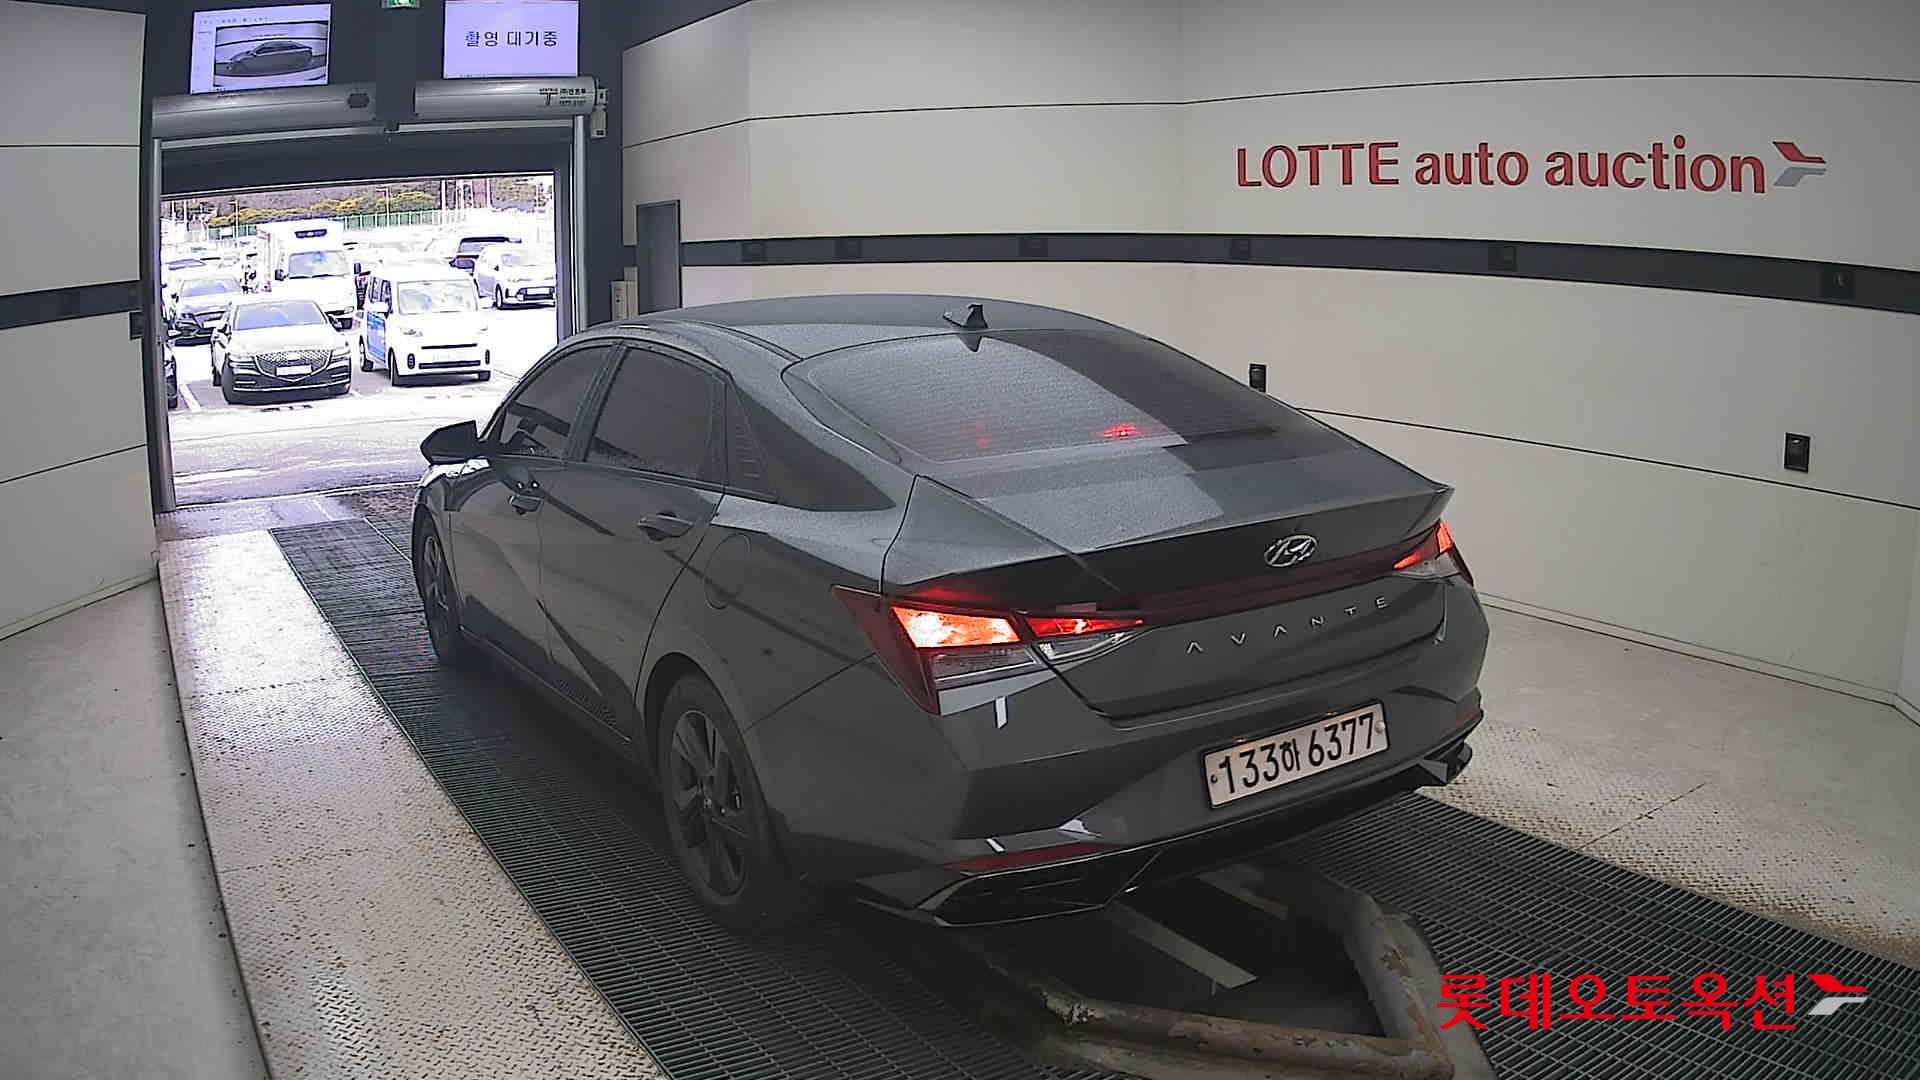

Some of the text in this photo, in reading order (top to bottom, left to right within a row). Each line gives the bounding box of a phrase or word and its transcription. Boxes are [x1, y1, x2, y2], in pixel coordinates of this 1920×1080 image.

[506, 30, 558, 47] 대기중
[1238, 135, 1765, 194] LOTTE auto auction
[1186, 595, 1389, 654] AVANTE
[1218, 712, 1374, 794] 133하 6377
